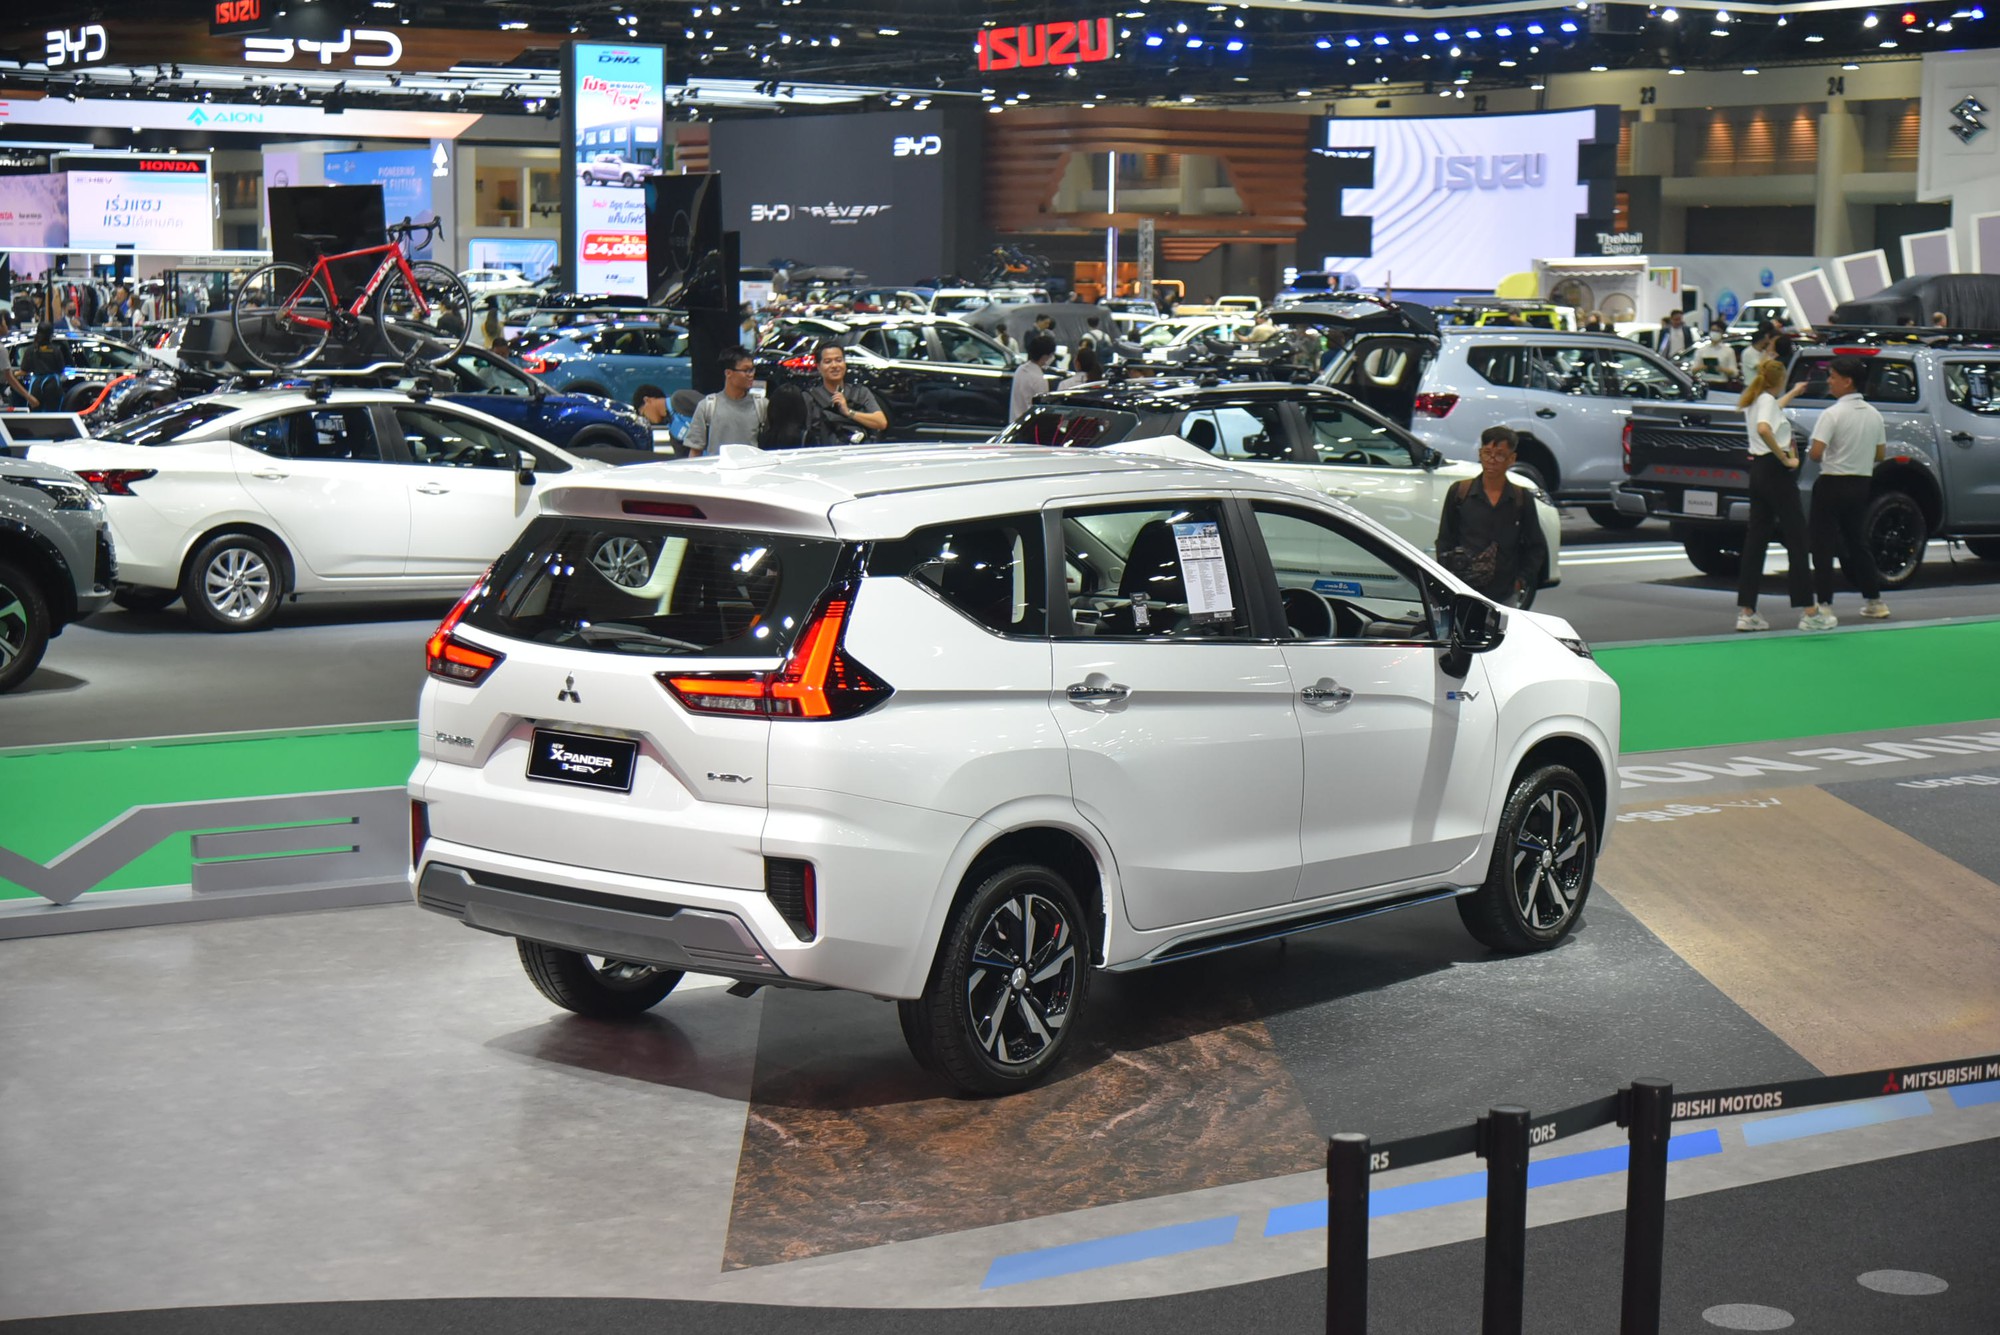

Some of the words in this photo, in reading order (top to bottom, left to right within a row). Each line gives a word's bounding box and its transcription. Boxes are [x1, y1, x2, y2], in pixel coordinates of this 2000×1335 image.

[215, 0, 261, 24] ISUZU
[46, 25, 107, 66] BYD
[977, 17, 1112, 72] ISUZU
[1640, 87, 1656, 104] 23
[1827, 77, 1844, 96] 24
[214, 112, 264, 125] AION
[893, 136, 942, 157] BYD
[139, 160, 200, 172] HONDA
[1434, 153, 1547, 191] ISUZU
[751, 204, 791, 221] BYD
[585, 243, 646, 256] 24,000
[549, 749, 613, 768] XPANDER
[1902, 1065, 1983, 1090] MITSUBISHI
[1986, 1062, 2000, 1079] M
[1719, 1091, 1783, 1113] MOTORS
